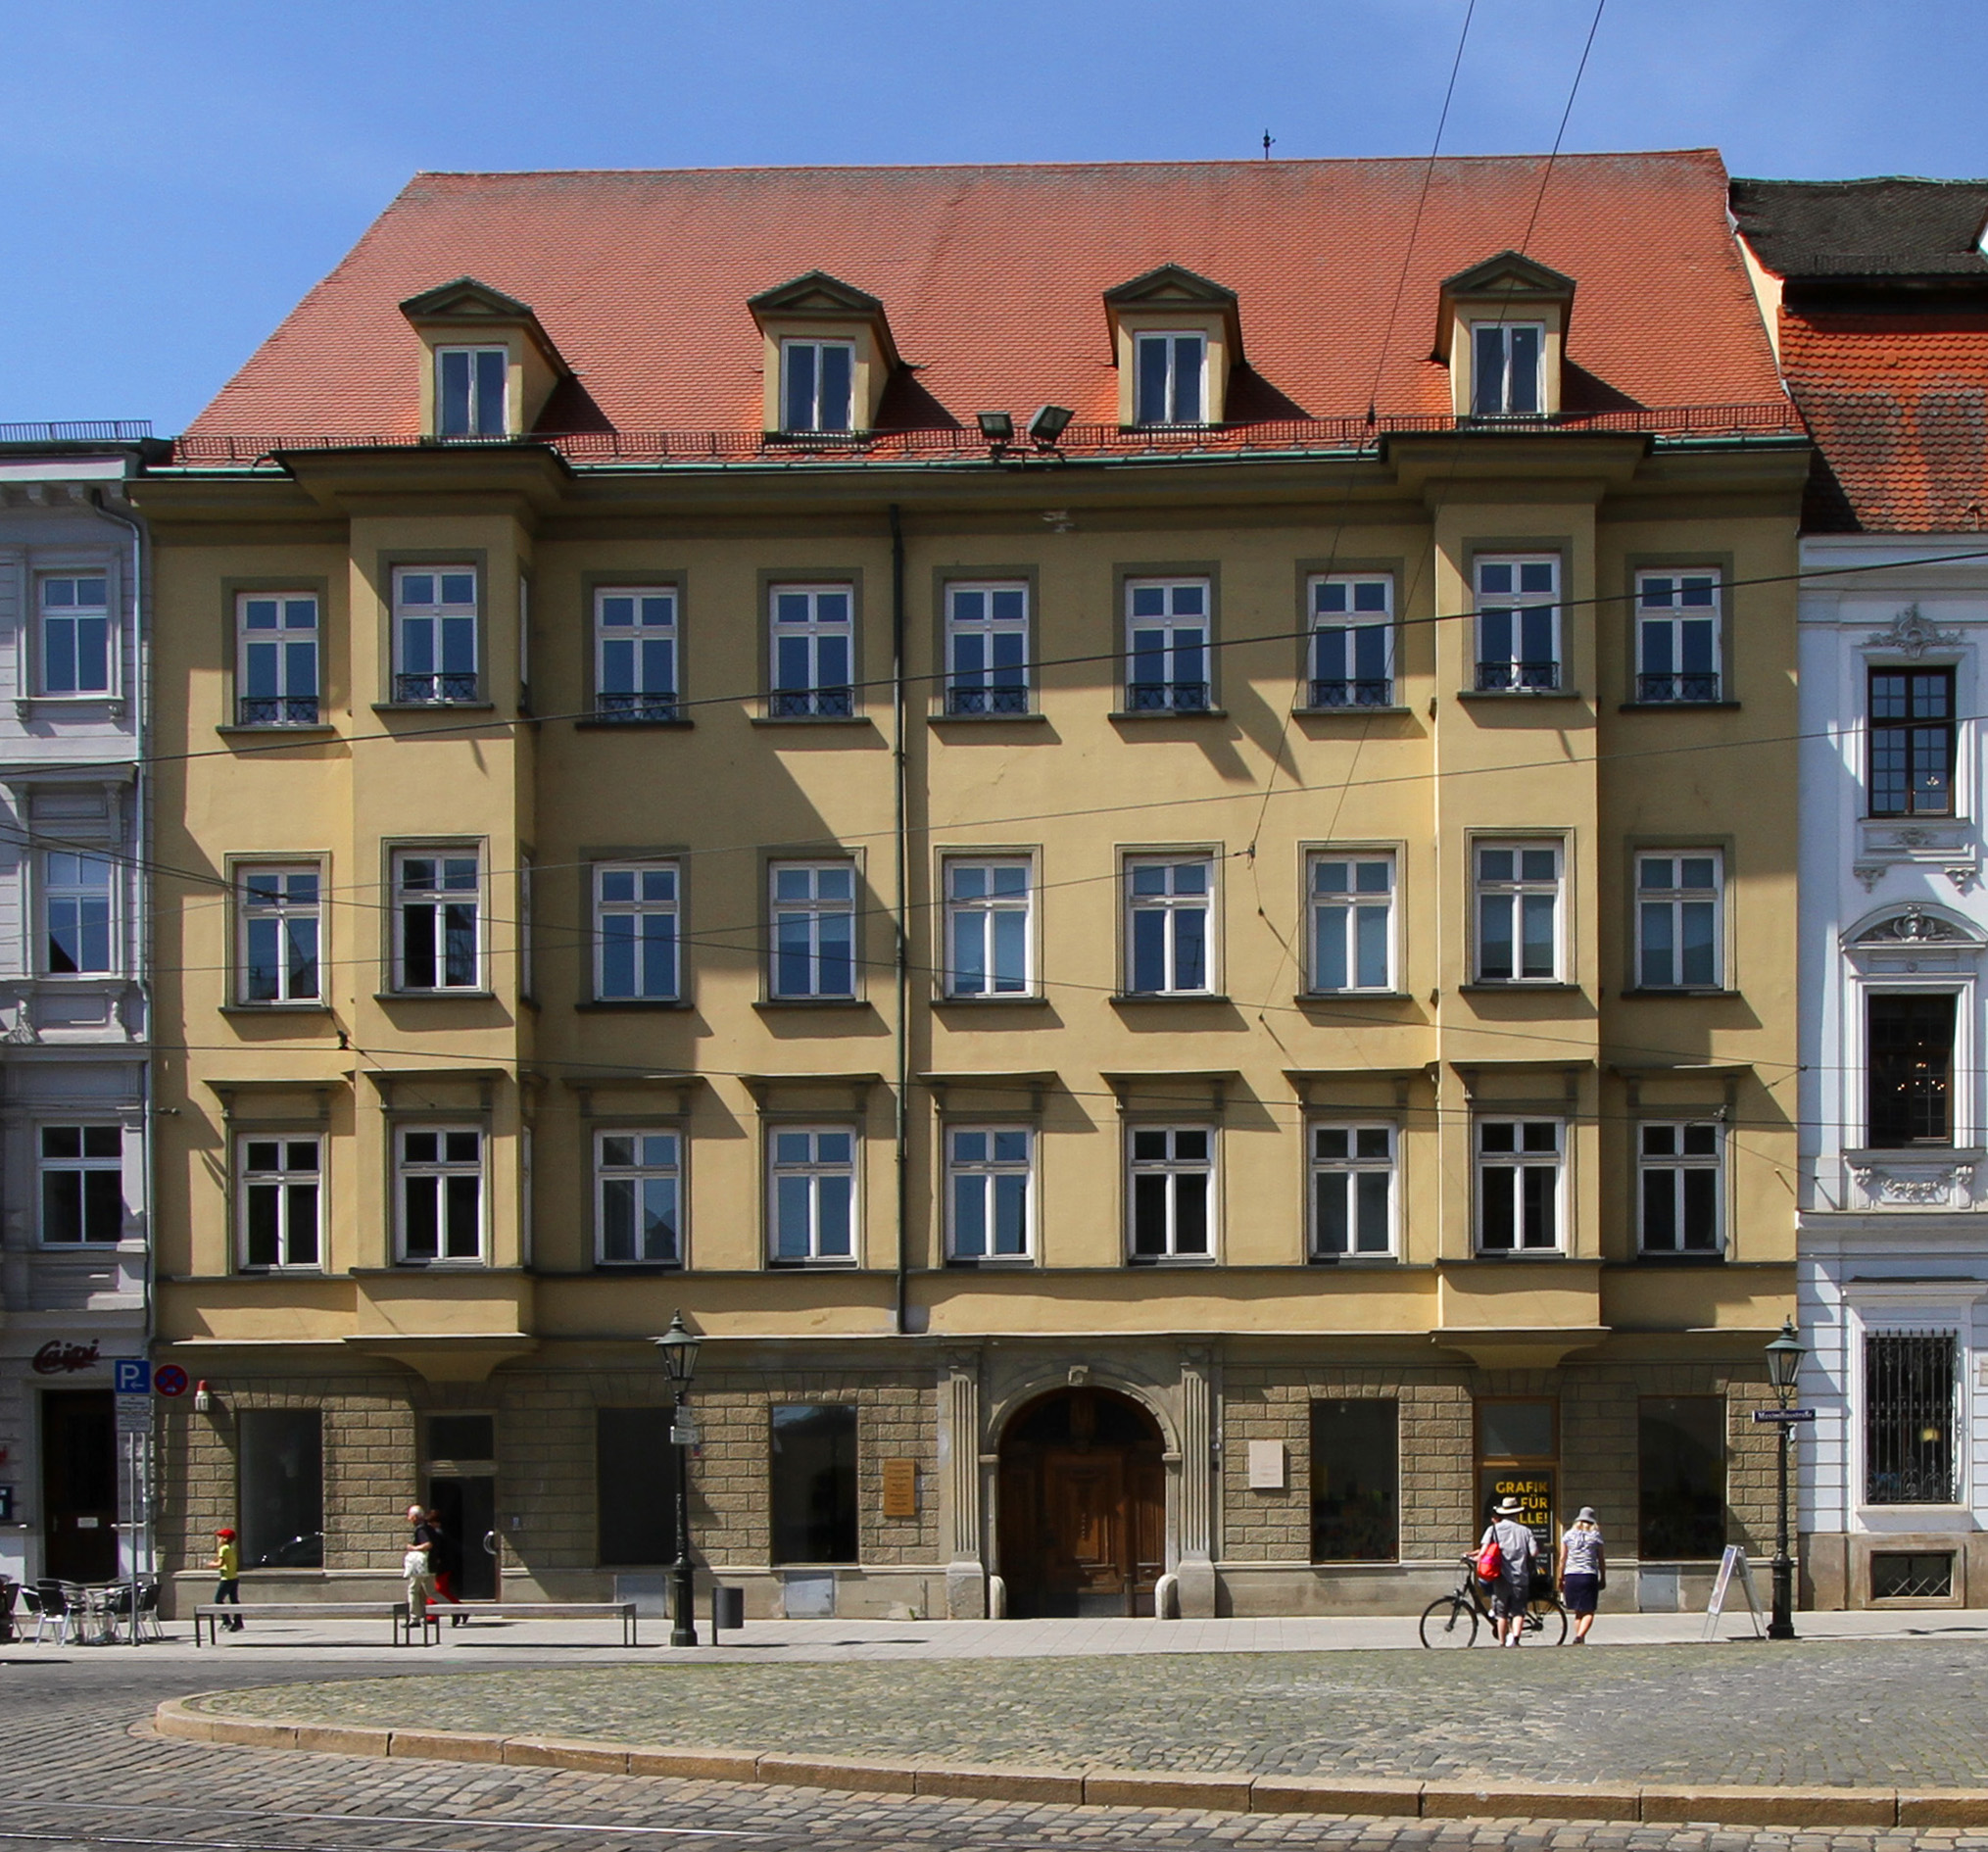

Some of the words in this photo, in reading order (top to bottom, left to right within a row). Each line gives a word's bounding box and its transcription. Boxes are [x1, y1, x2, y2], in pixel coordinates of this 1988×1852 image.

[32, 1339, 100, 1375] Caipi
[121, 1364, 139, 1389] P
[1495, 1481, 1548, 1494] GRAFIK
[1521, 1493, 1548, 1508] FÜR
[1517, 1512, 1548, 1525] LLE!
